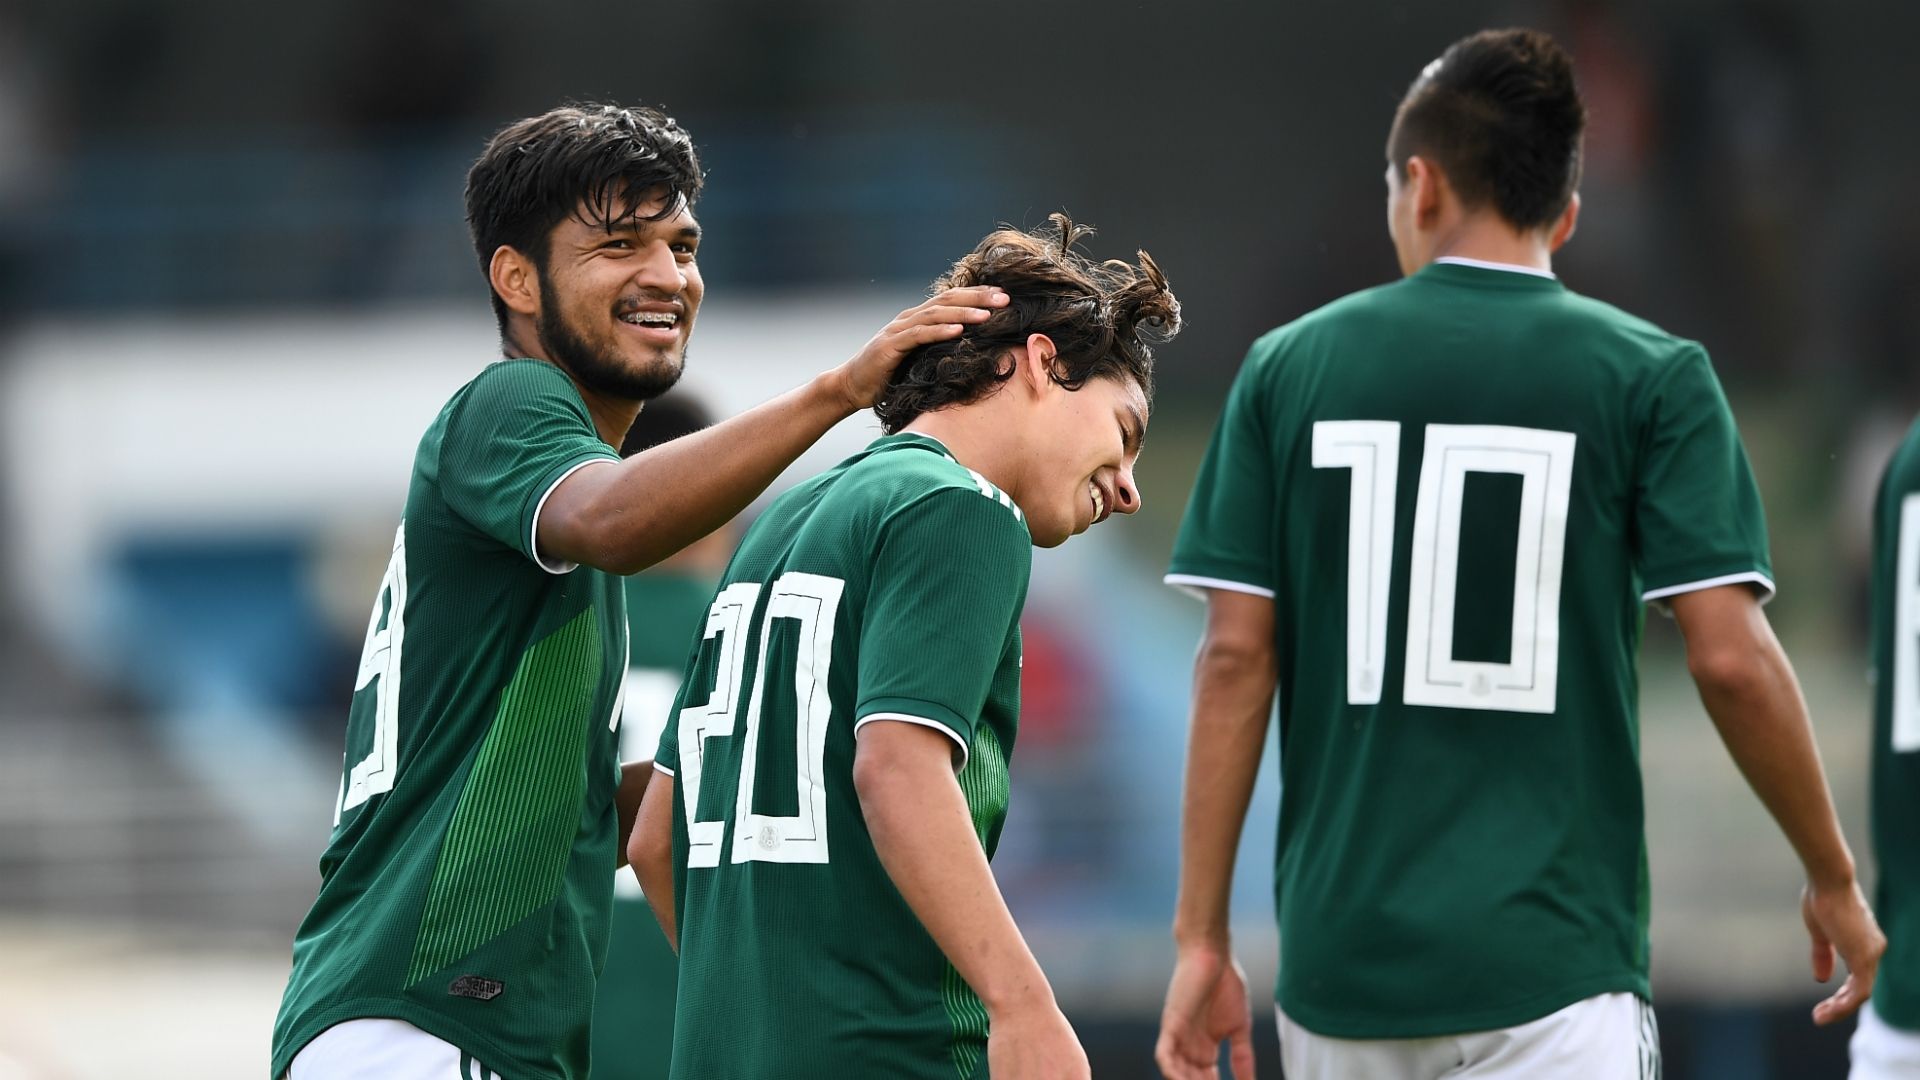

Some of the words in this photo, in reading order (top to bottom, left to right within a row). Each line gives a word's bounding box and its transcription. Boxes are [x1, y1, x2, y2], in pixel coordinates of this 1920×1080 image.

[333, 518, 407, 827] 9
[1312, 420, 1577, 714] 10
[678, 571, 845, 868] 20
